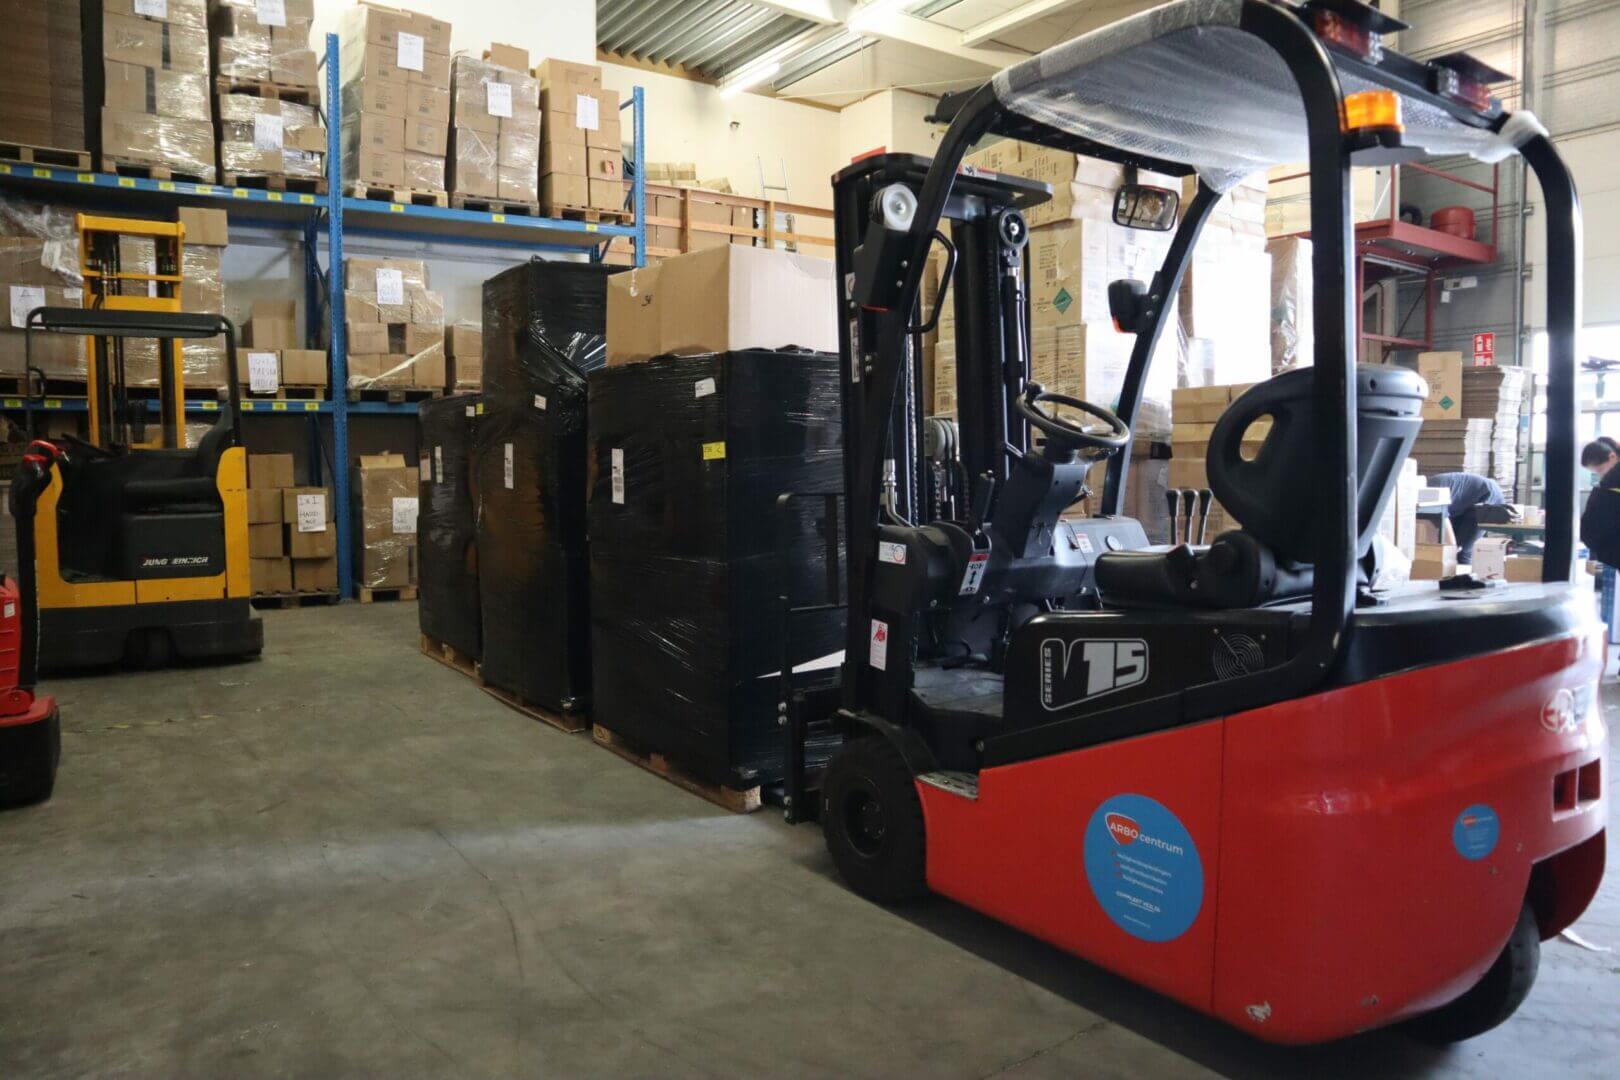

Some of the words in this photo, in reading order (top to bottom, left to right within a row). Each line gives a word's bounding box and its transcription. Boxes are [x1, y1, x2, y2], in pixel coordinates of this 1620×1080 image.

[1043, 647, 1053, 704] SERIES
[1110, 821, 1139, 840] ARBO
[1139, 834, 1184, 856] centrum
